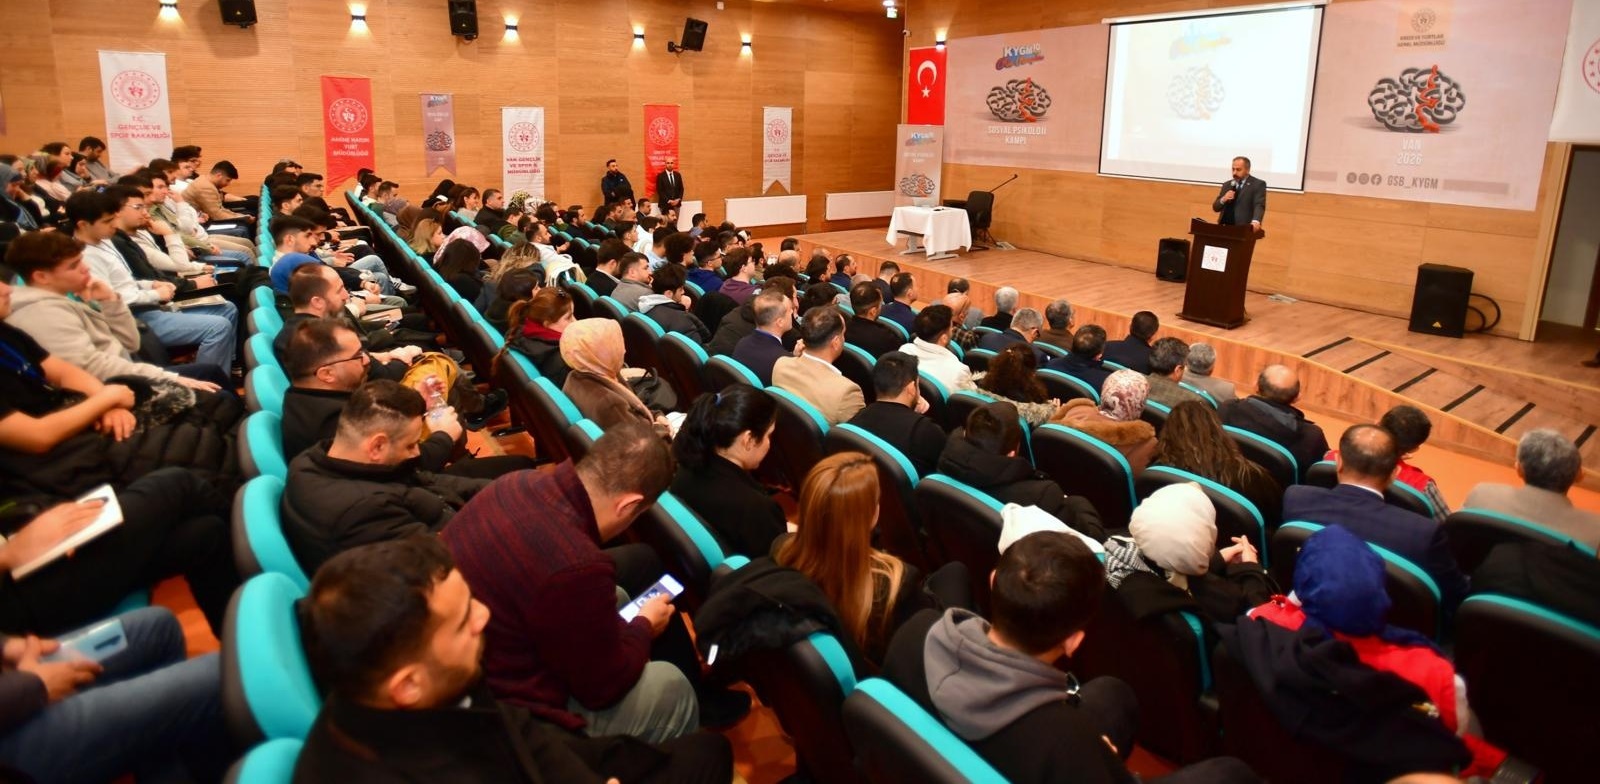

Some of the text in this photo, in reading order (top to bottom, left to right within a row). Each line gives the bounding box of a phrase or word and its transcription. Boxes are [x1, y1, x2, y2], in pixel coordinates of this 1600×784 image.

[1004, 46, 1033, 57] KYGM
[1401, 138, 1421, 150] VAN
[1397, 152, 1423, 165] 2026
[1387, 174, 1439, 190] GSB_KYGM
